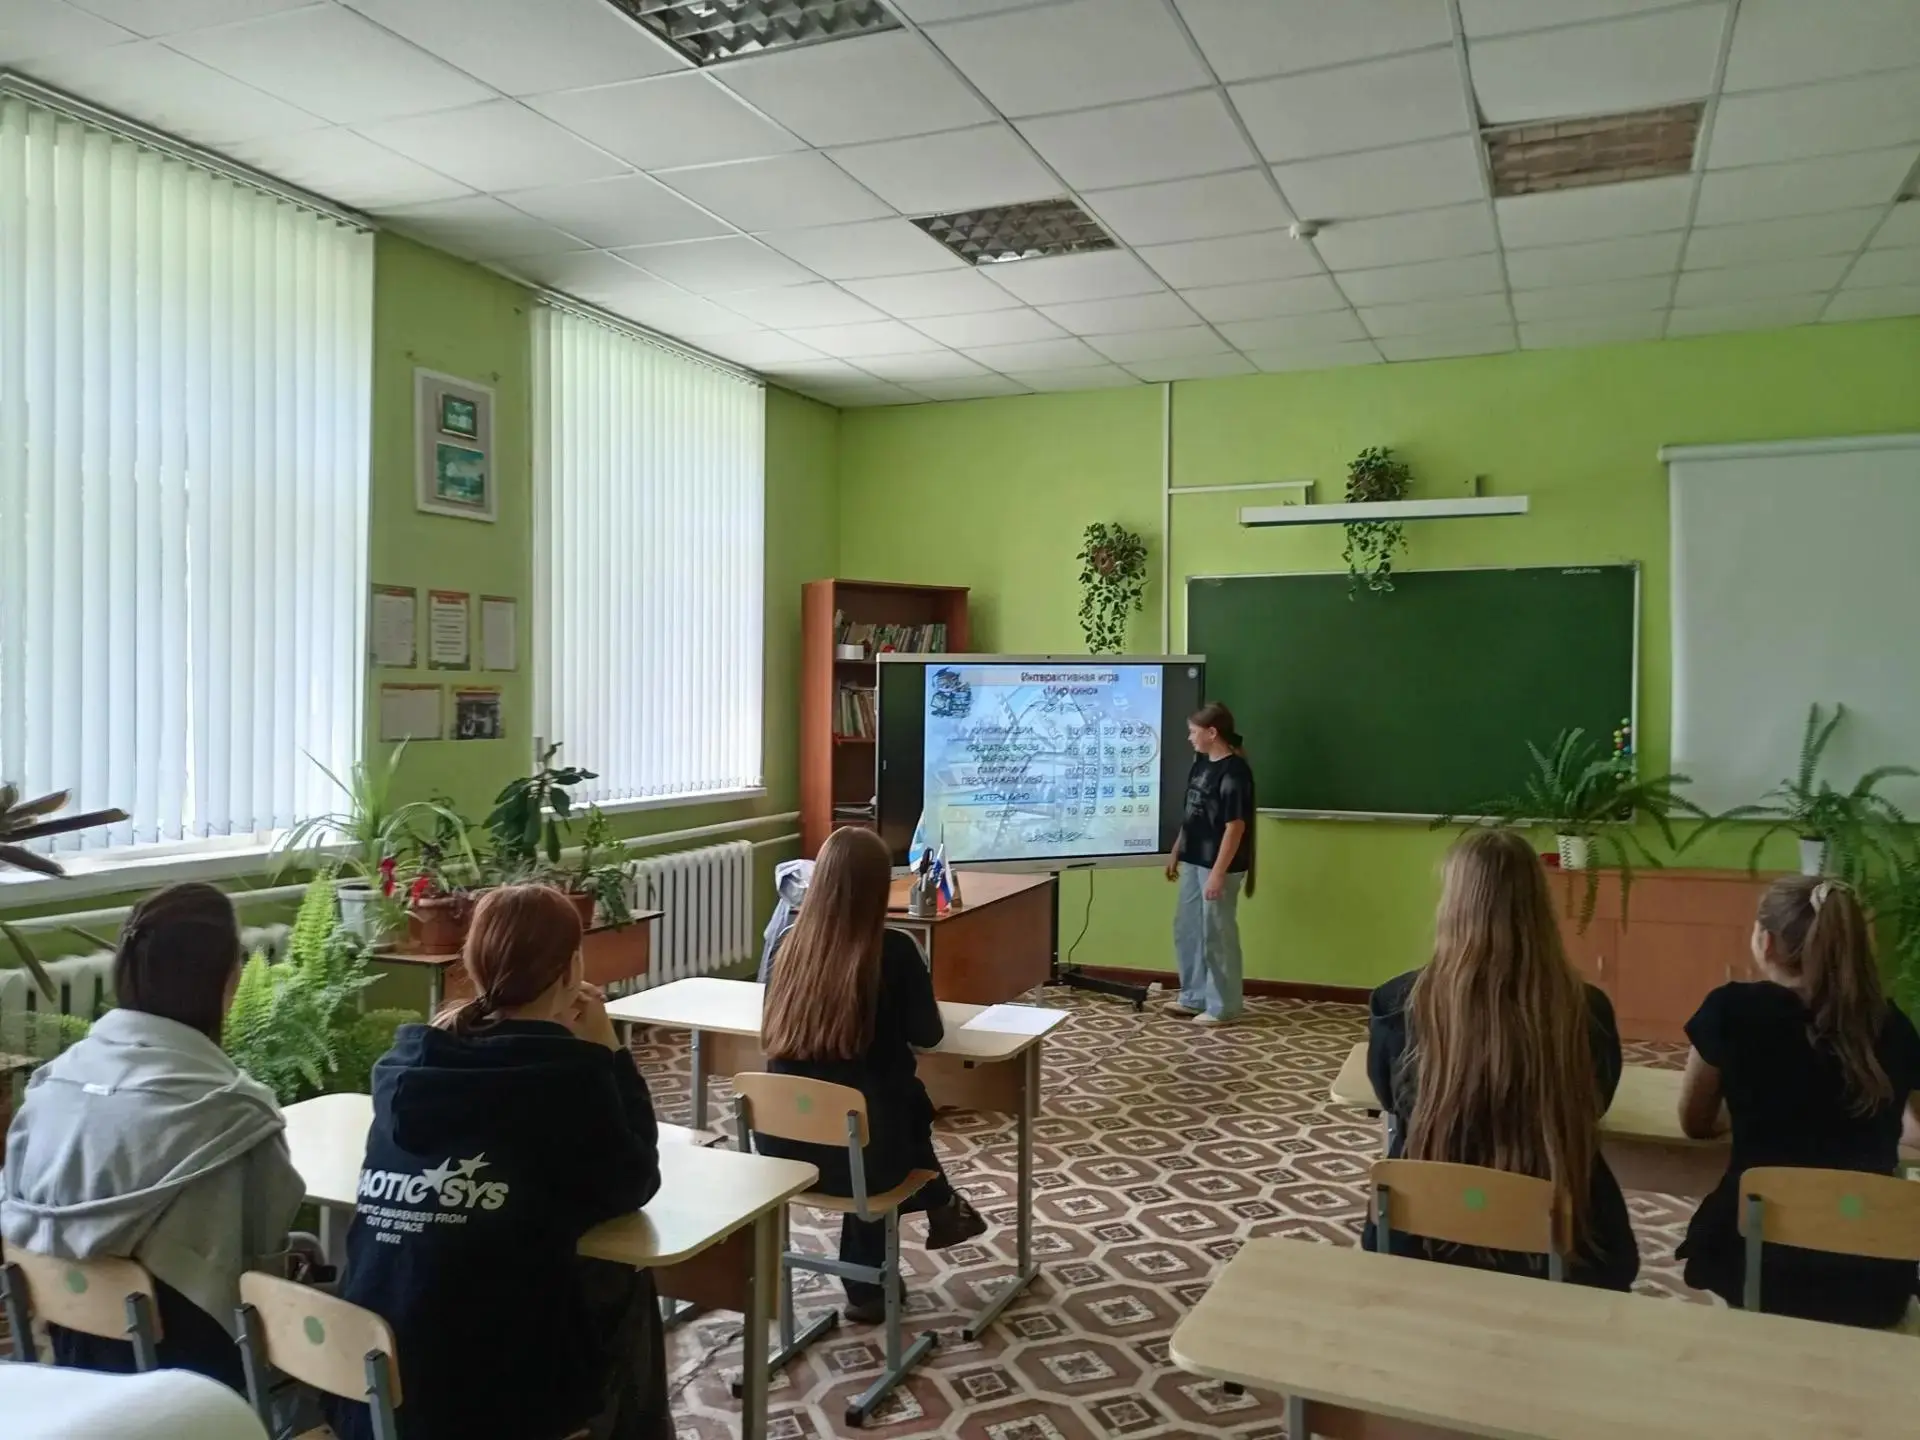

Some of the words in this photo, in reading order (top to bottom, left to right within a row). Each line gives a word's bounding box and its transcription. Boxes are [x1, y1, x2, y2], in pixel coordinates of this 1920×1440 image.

[1021, 671, 1096, 683] Интерактивная
[1098, 672, 1120, 685] игра
[1143, 675, 1156, 686] 10
[358, 1168, 428, 1205] AOTIC
[439, 1177, 509, 1210] SYS
[366, 1215, 382, 1227] OUT
[381, 1219, 394, 1229] OF
[393, 1221, 425, 1233] SPACE
[380, 1207, 433, 1223] AWARENESS
[434, 1213, 468, 1225] FROM
